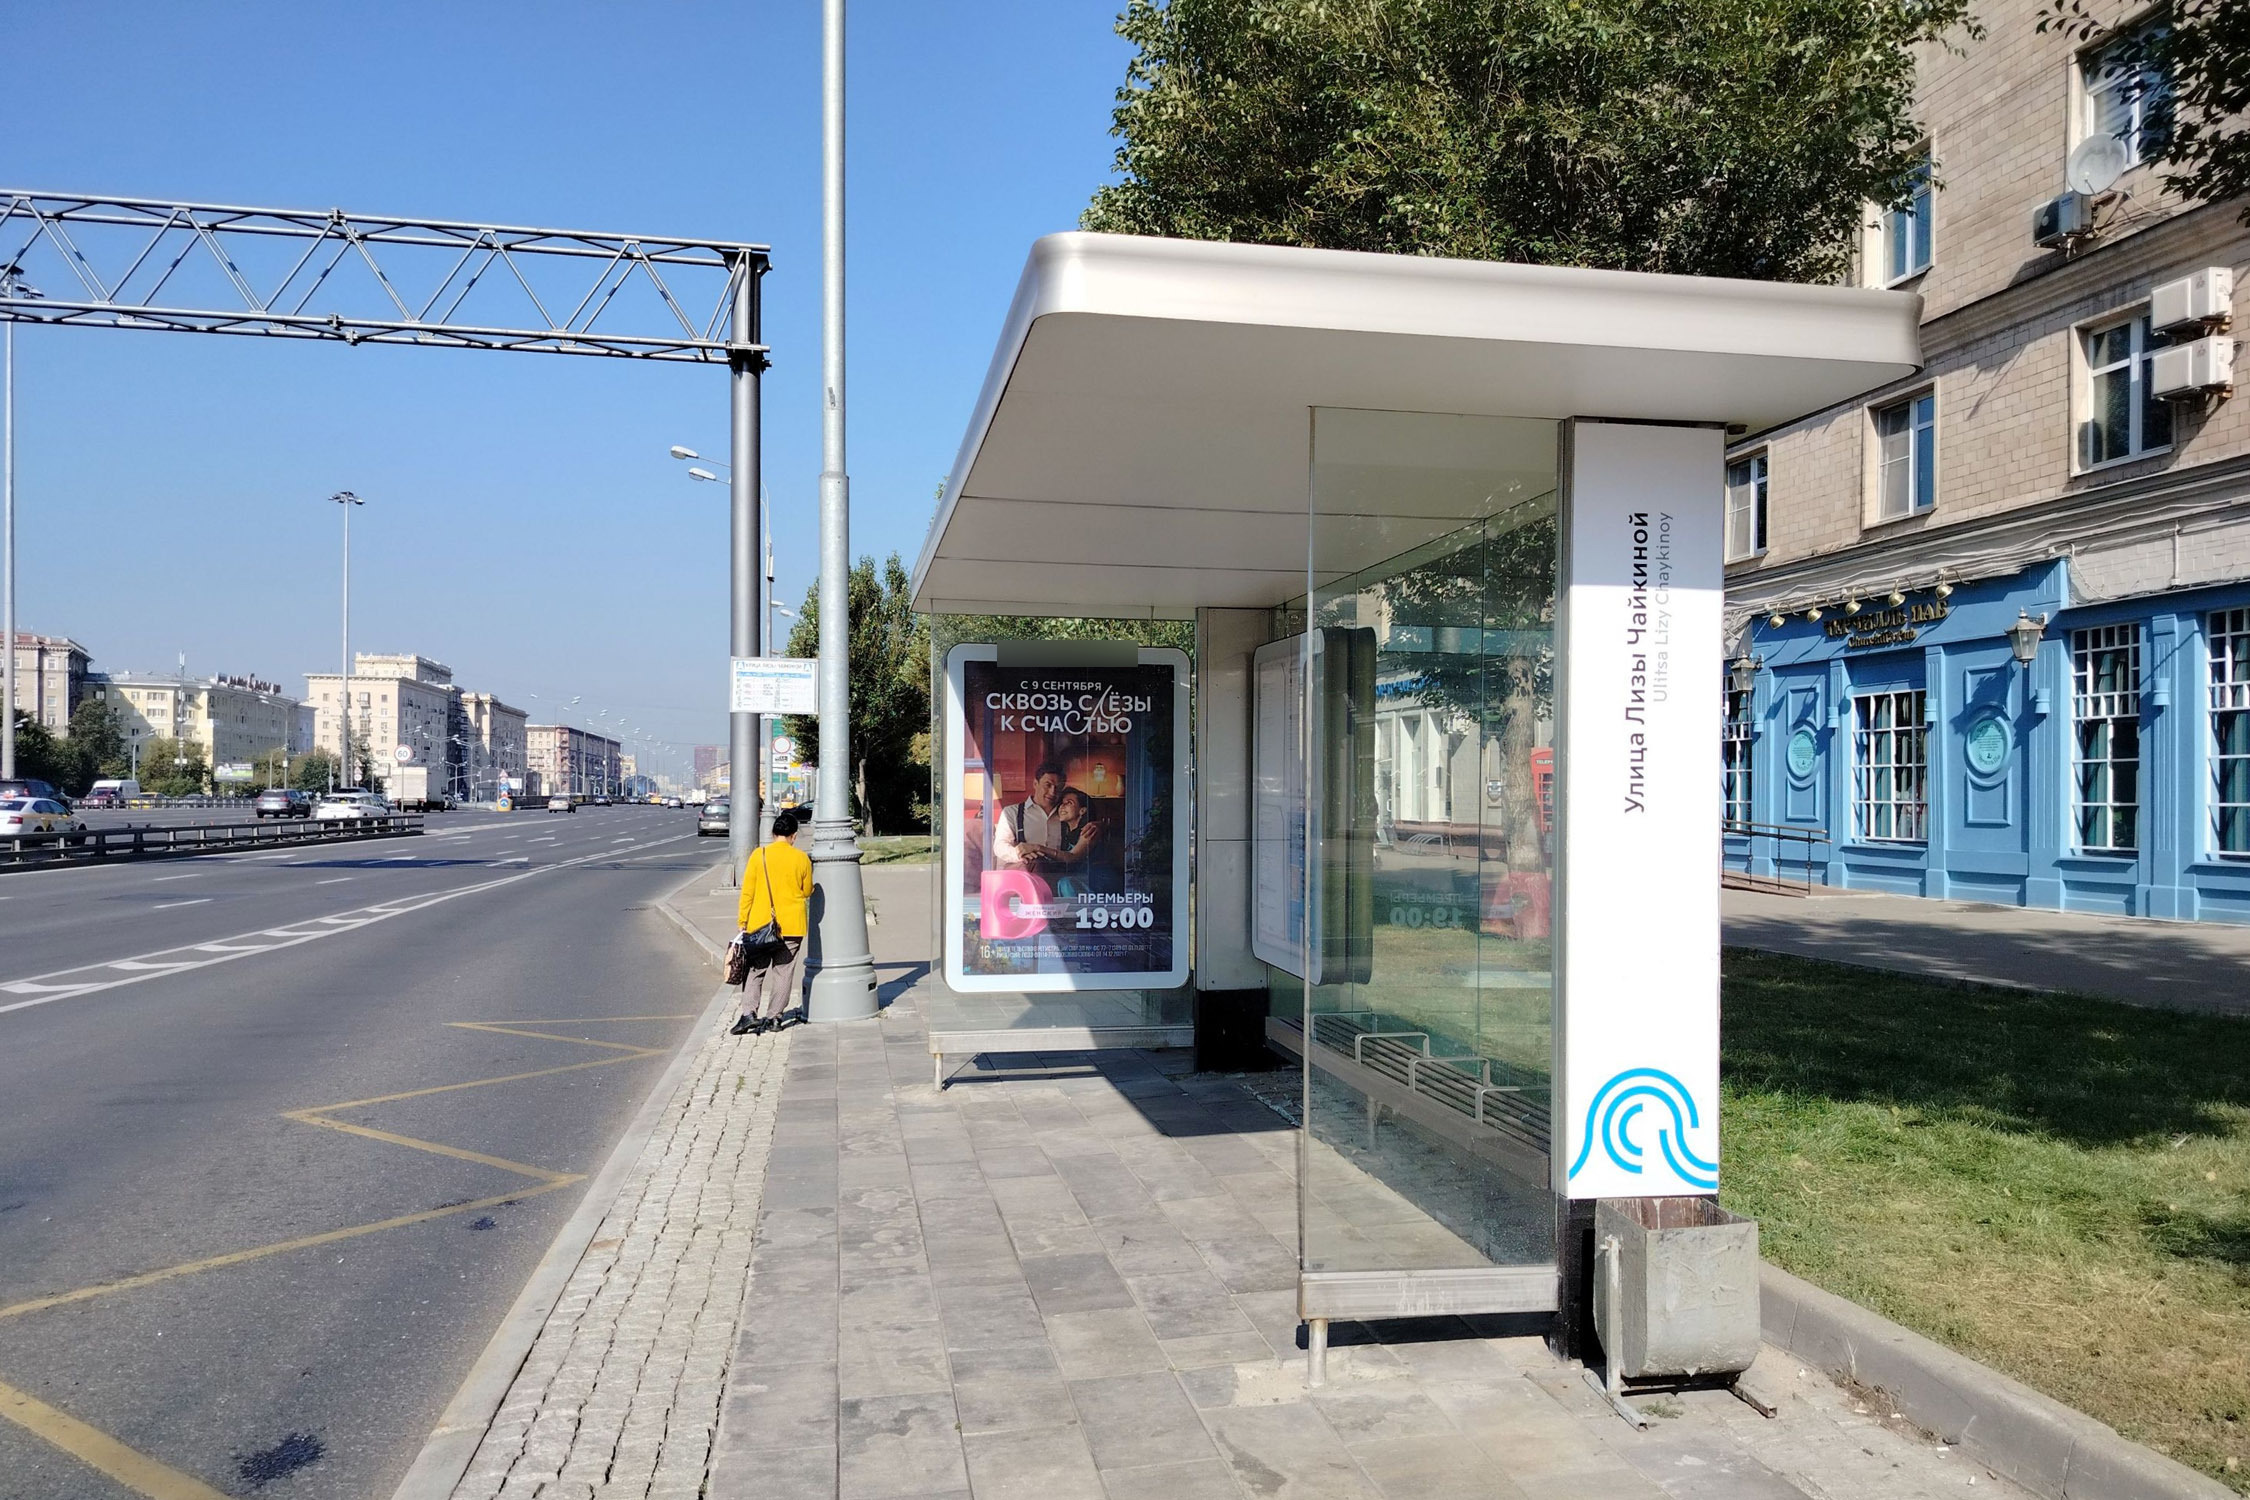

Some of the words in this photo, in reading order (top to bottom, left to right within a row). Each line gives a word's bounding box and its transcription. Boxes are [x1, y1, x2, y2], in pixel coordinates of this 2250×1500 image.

[1655, 512, 1673, 605] Chaykinoy
[1627, 512, 1649, 645] Чайкиной
[1655, 609, 1673, 645] Lizy
[1911, 600, 1948, 622] ПАБ
[1020, 680, 1028, 690] С
[1032, 681, 1039, 690] 9
[1042, 681, 1102, 691] СЕНТЯБРЯ
[1626, 653, 1646, 724] Лизы
[1653, 651, 1668, 703] Ulitsa
[986, 692, 1073, 711] СКВОЗЬ
[1078, 685, 1151, 719] СЛЁЗЫ
[1001, 715, 1015, 732] К
[1021, 710, 1133, 735] СЧАСТЬЮ
[397, 750, 408, 758] 60
[1624, 732, 1648, 814] Улица
[1077, 892, 1153, 904] ПРЕМЬЕРЫ
[1075, 907, 1154, 929] 19:00
